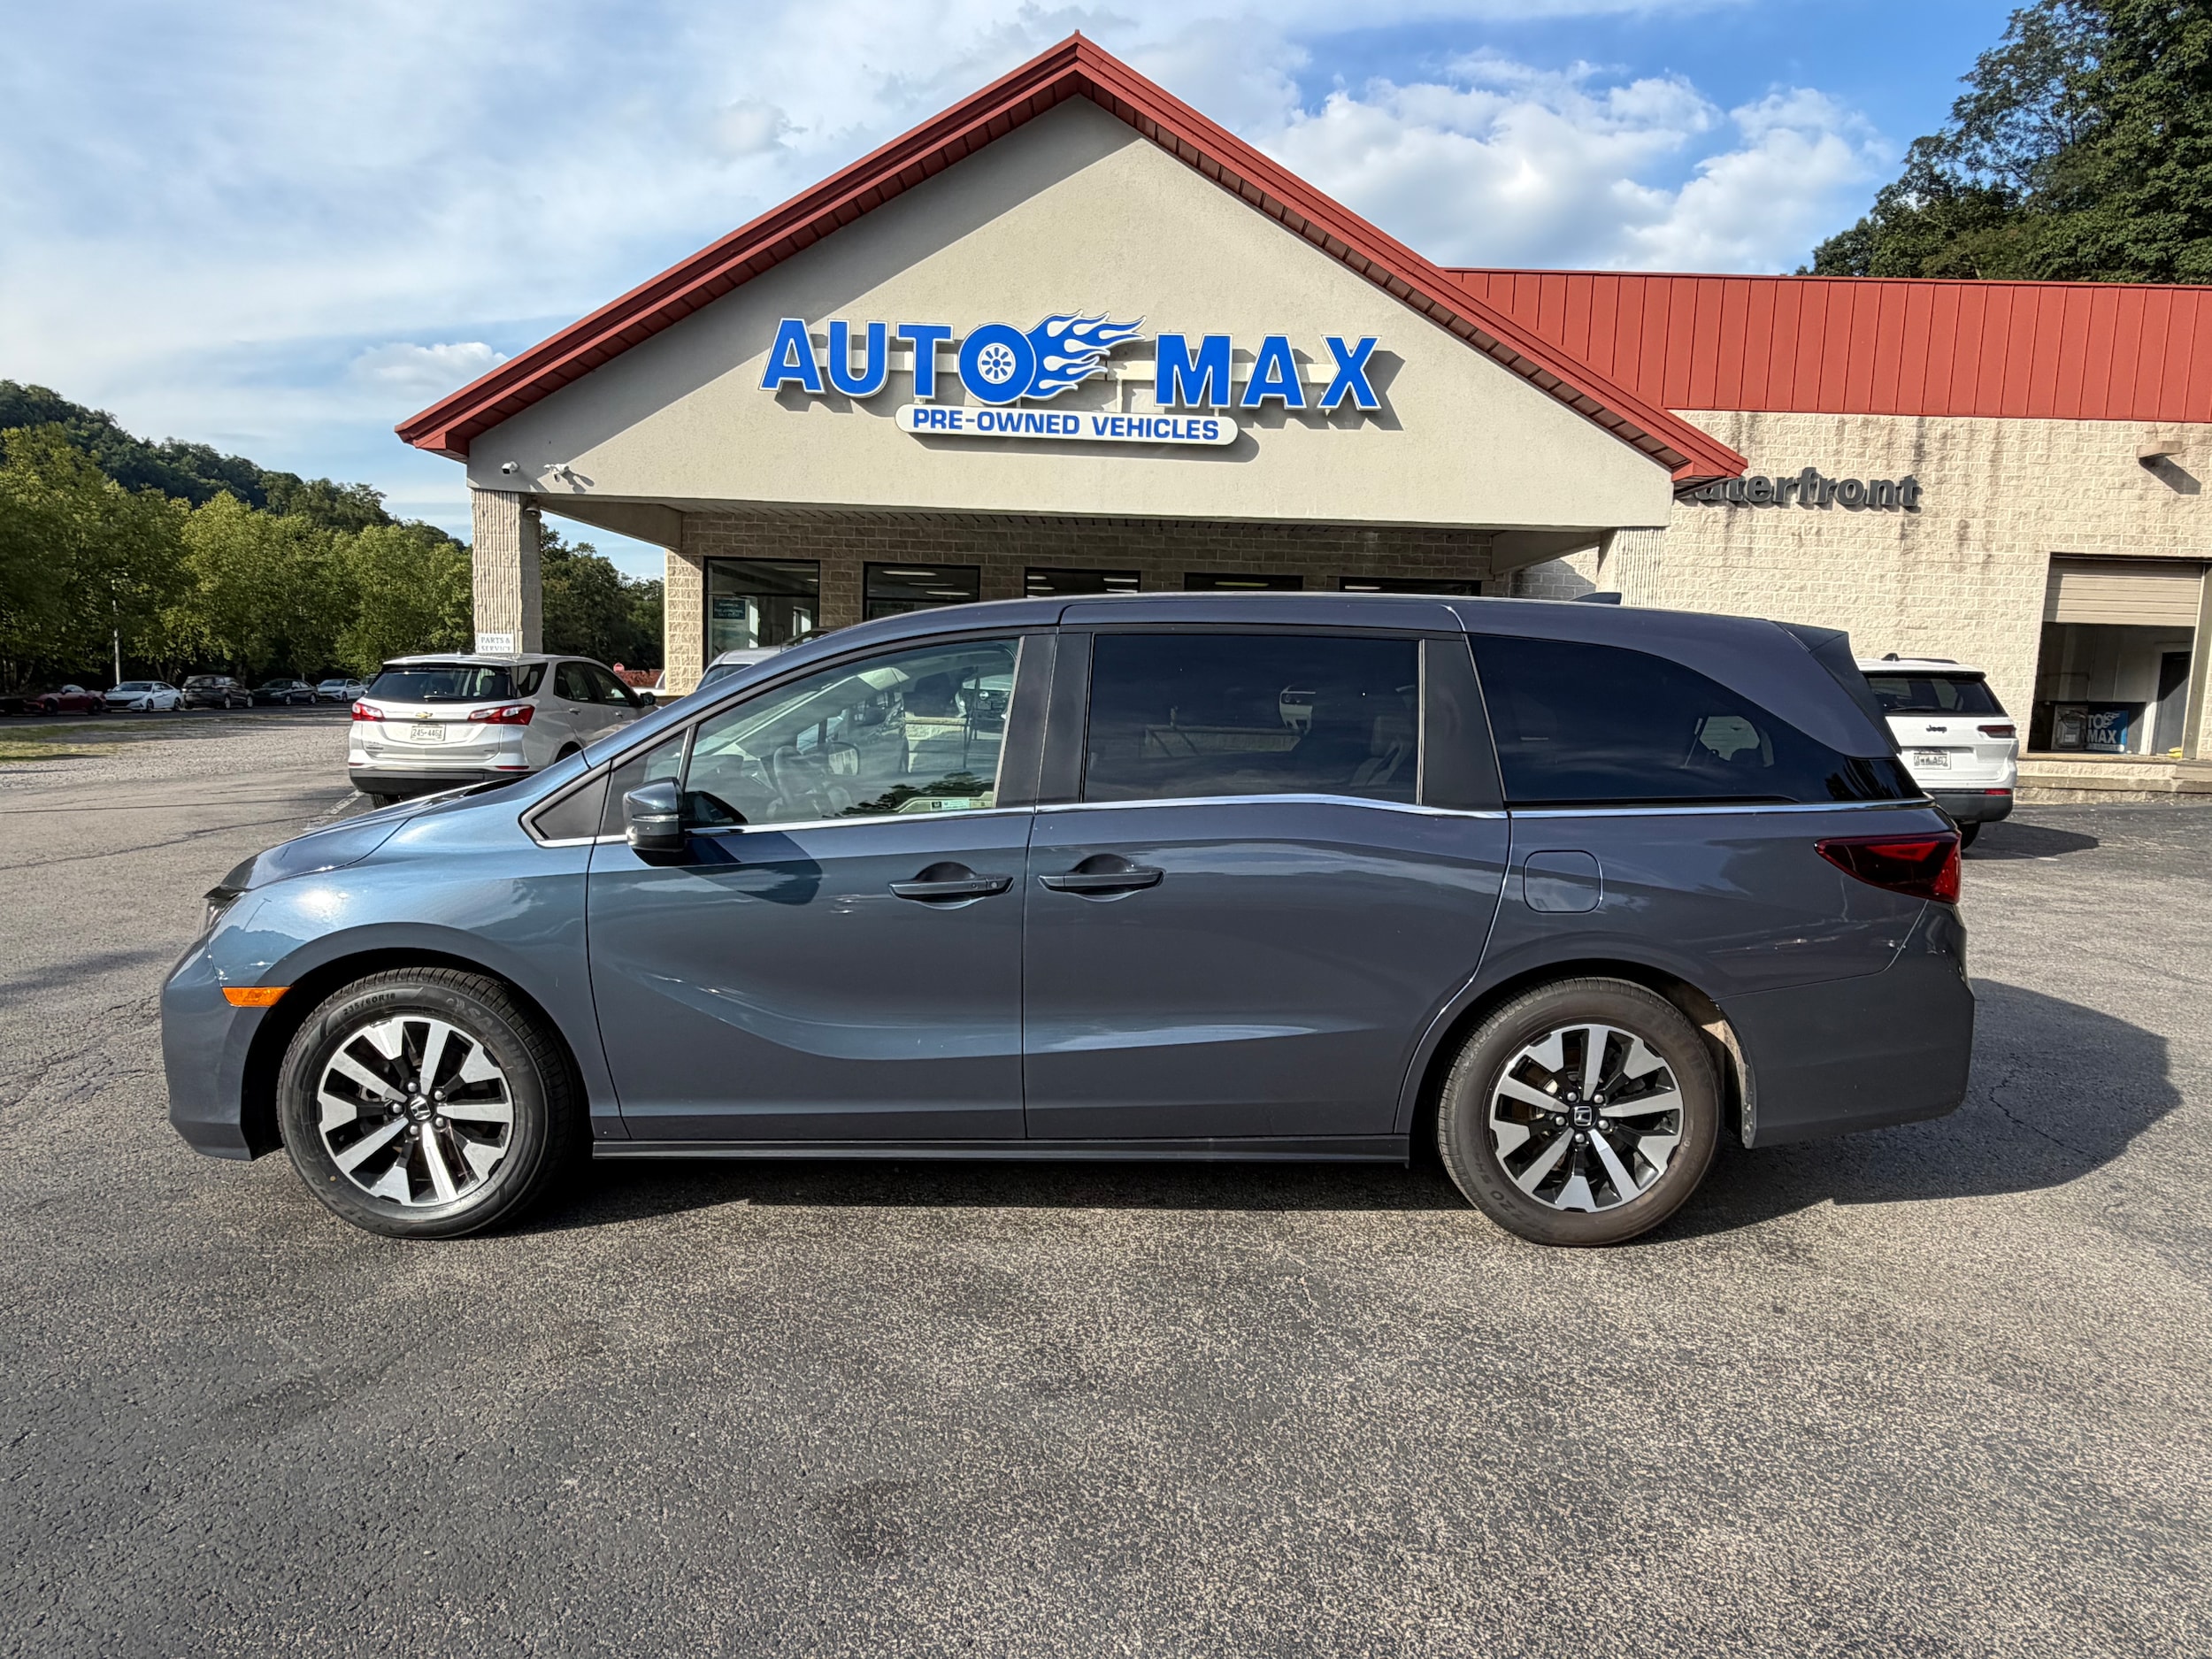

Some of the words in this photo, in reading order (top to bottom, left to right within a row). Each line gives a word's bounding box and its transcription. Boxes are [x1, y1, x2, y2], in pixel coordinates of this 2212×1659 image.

[758, 317, 1037, 406] AUTO
[1154, 332, 1383, 411] MAX
[912, 409, 1080, 435] PRE-OWNED
[1091, 415, 1220, 441] VEHICLES
[1678, 466, 1920, 507] aterfront
[2087, 729, 2117, 744] MAX
[342, 992, 396, 1016] 235/60R18
